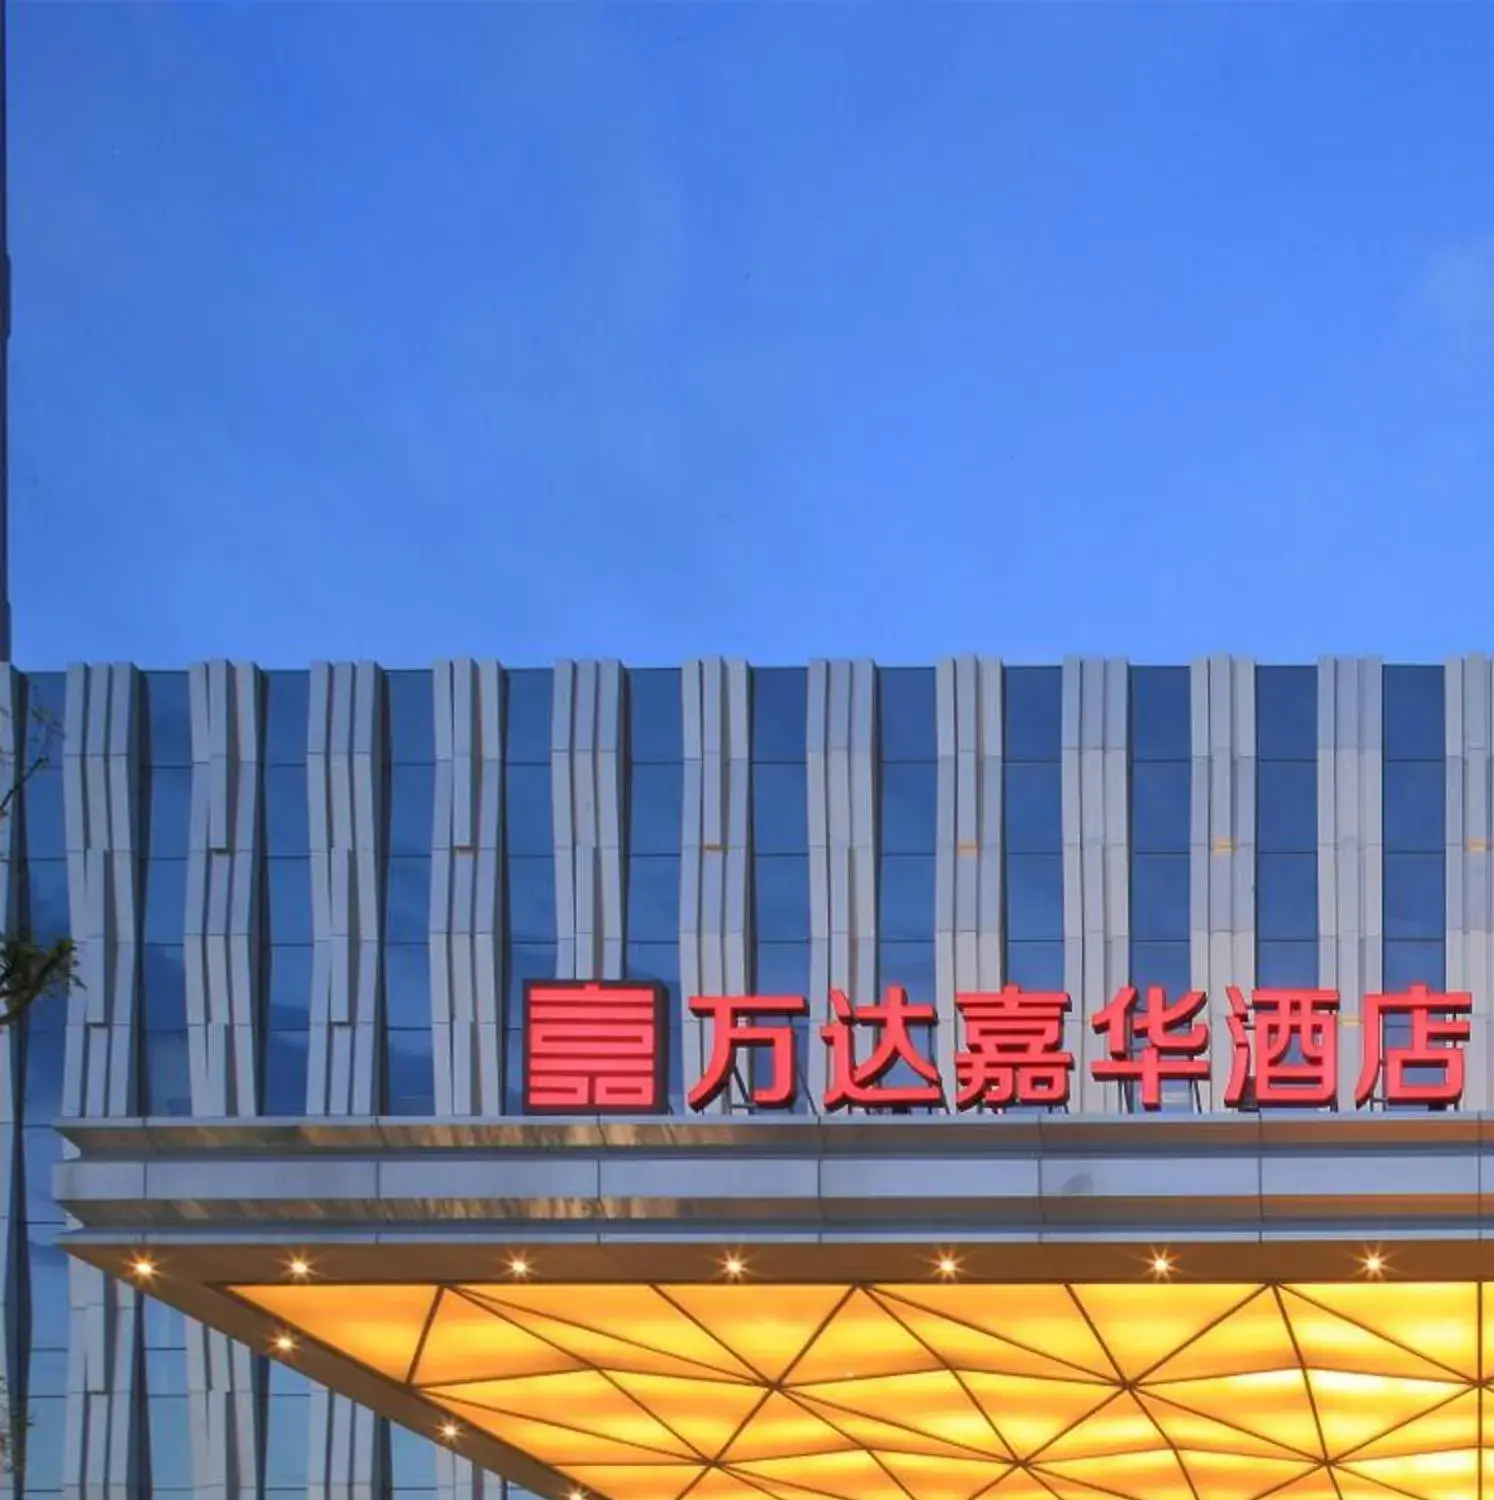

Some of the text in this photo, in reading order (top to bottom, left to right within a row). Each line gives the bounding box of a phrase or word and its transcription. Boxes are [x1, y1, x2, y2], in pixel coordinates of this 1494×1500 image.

[687, 984, 1473, 1109] 万达嘉华酒店
